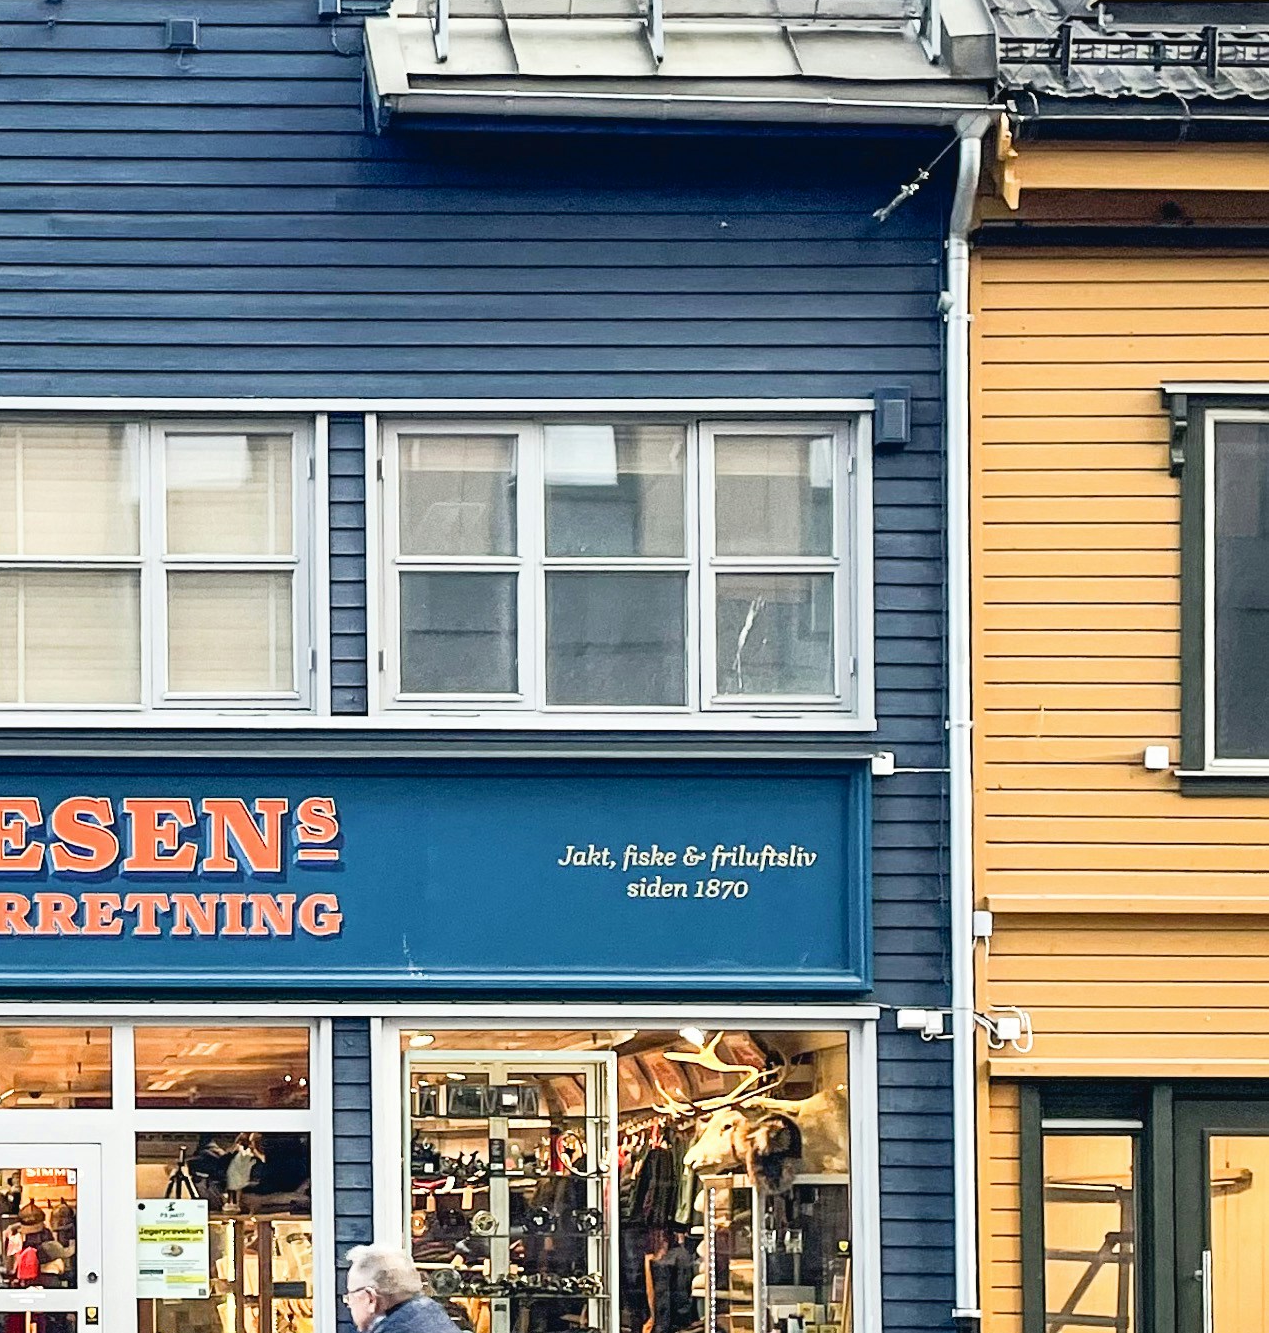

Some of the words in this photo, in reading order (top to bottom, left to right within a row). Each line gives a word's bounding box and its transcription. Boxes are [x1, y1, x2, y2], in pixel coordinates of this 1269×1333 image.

[557, 844, 617, 871] Jakt,
[621, 844, 677, 873] fiske
[682, 845, 707, 867] &
[709, 844, 818, 874] friluftsliv
[626, 875, 688, 900] siden
[693, 878, 749, 901] 1870
[25, 1168, 67, 1177] SIMM
